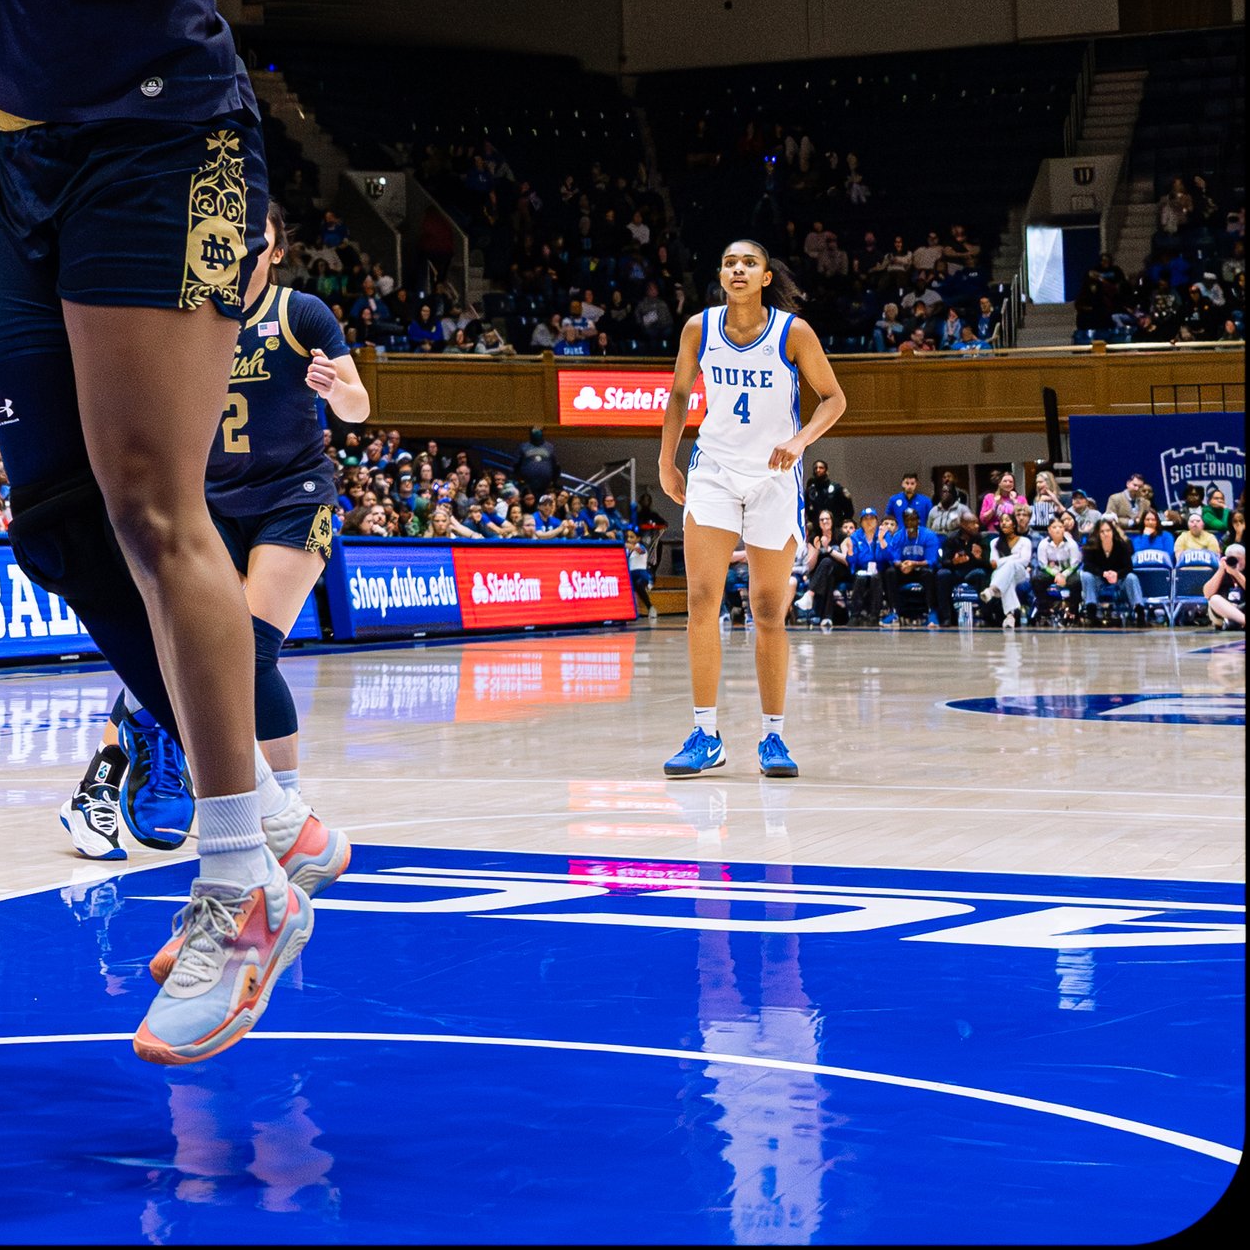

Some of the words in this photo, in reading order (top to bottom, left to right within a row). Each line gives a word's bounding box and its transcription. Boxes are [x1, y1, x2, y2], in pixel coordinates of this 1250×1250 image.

[711, 365, 773, 389] DUKE
[733, 392, 751, 425] 4
[1137, 552, 1164, 564] DUKE
[1184, 551, 1211, 563] DUKE
[350, 567, 458, 617] shop.duke.edu
